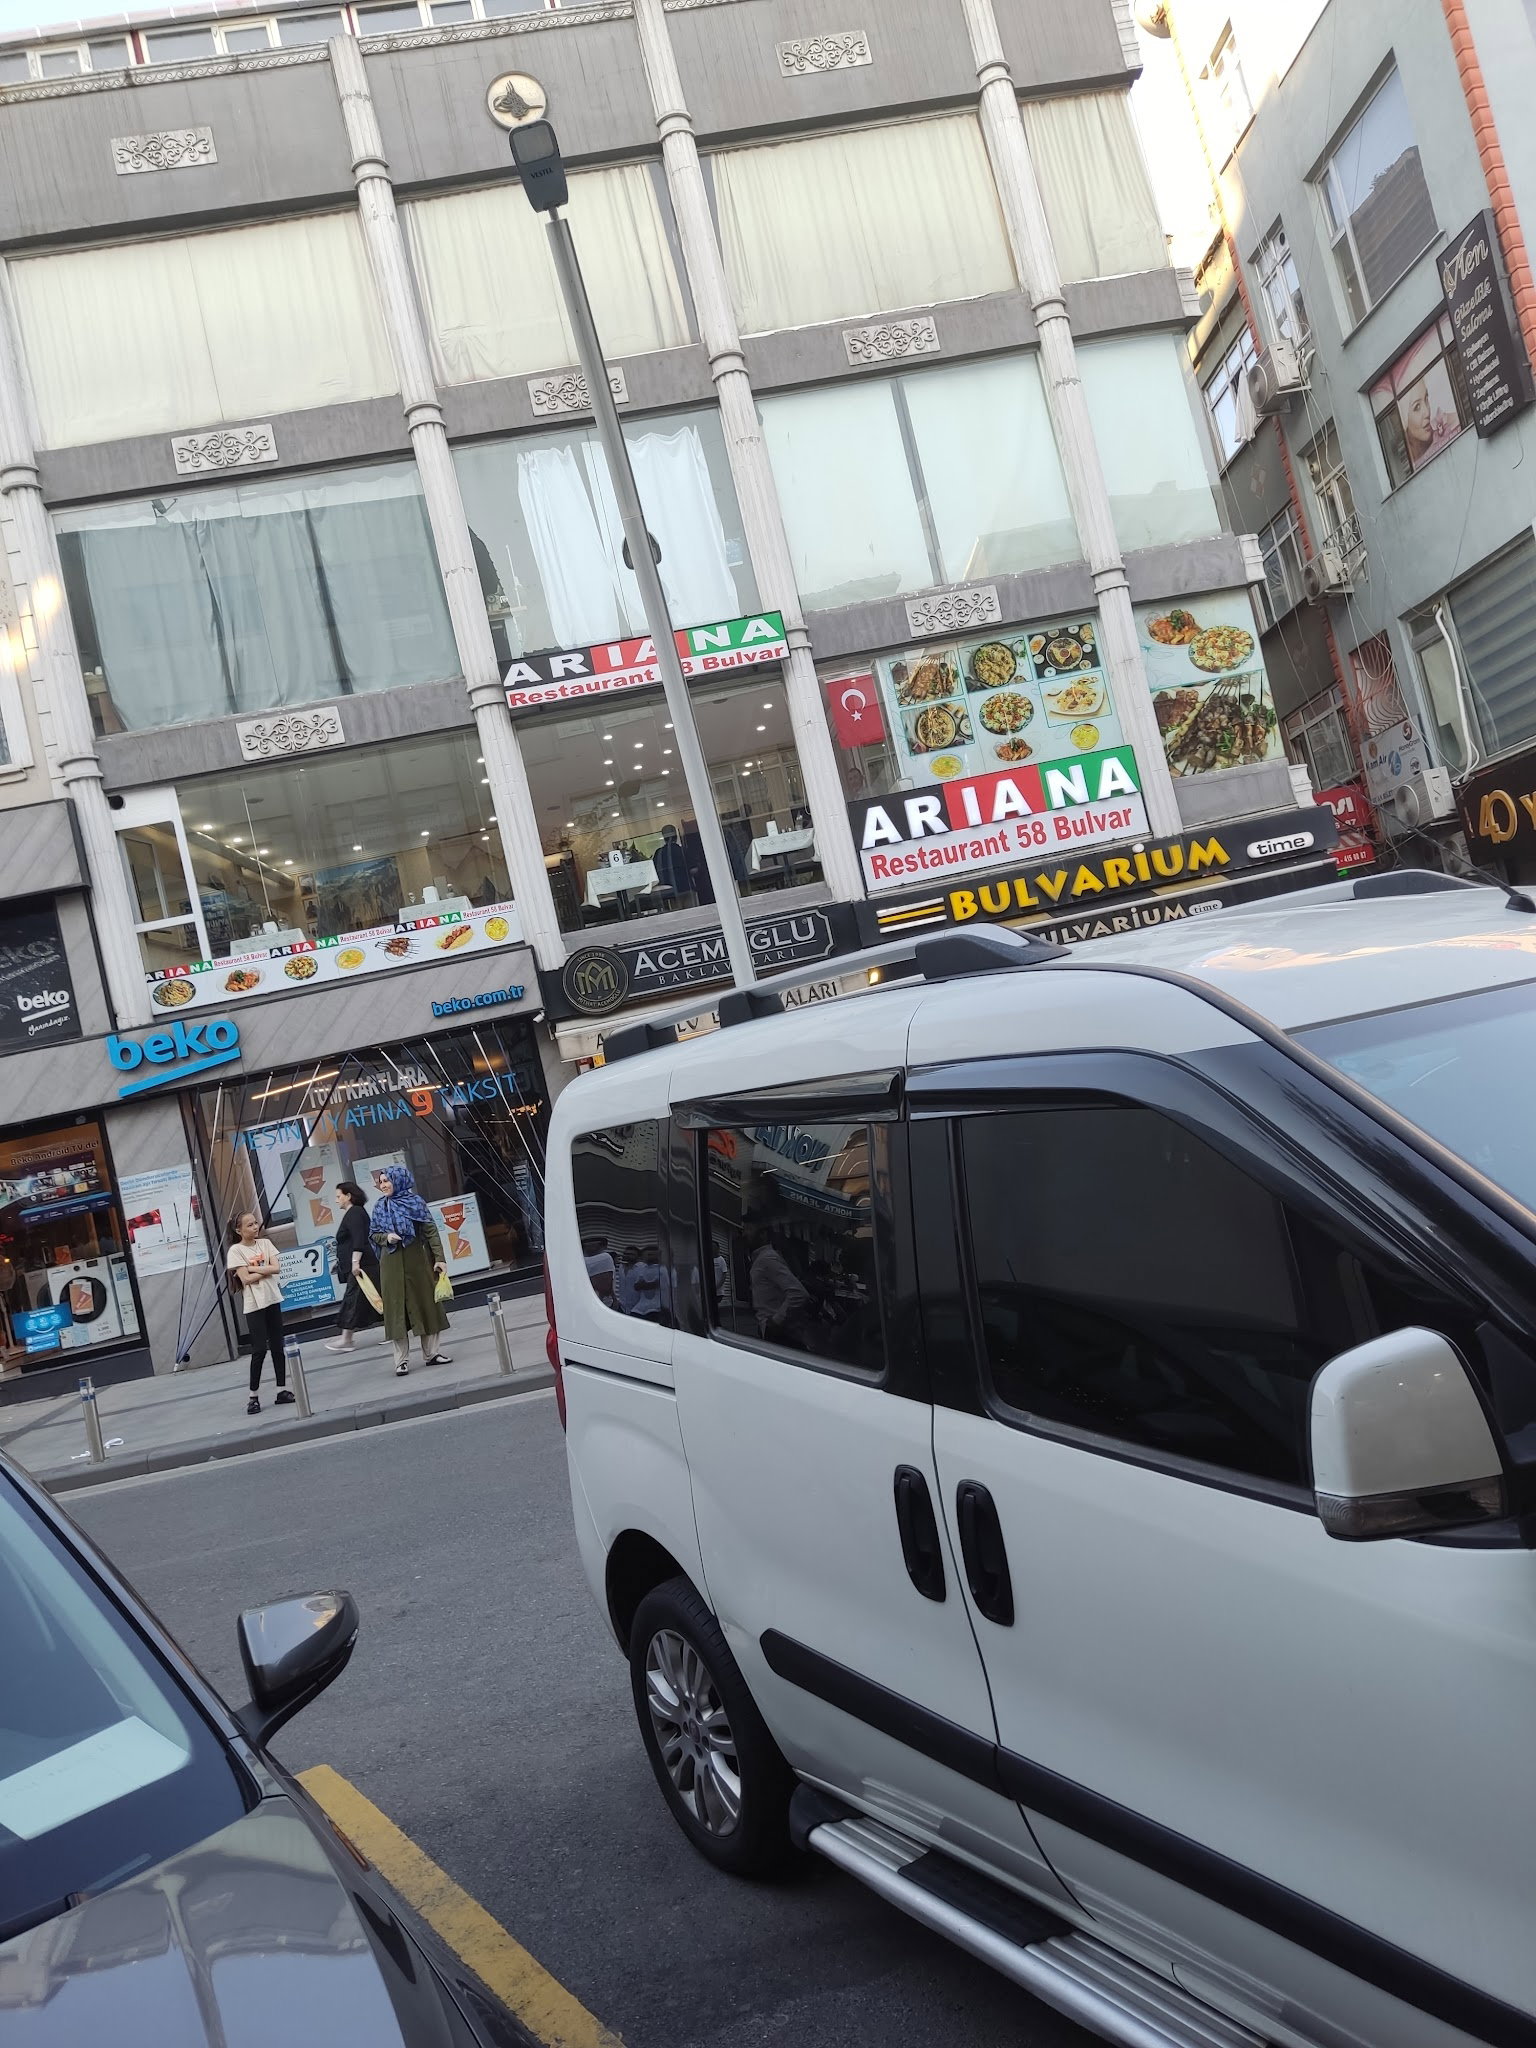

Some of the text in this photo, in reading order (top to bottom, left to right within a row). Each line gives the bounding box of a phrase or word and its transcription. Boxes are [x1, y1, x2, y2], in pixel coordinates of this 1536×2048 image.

[530, 167, 553, 179] VESTEL
[509, 668, 655, 707] Restaurant
[703, 646, 785, 670] Bulvar
[861, 757, 1139, 849] ARIANA
[613, 853, 620, 863] 6
[870, 807, 1132, 880] Restaurant 58 Bulvar
[949, 836, 1305, 922] BULVARİUM time
[145, 960, 212, 982] ARIANA
[214, 955, 243, 968] Restaurant
[271, 937, 338, 959] ARIANA
[340, 931, 368, 943] Restaurant
[396, 913, 461, 933] ARIANA
[463, 907, 490, 919] Restaurant
[1039, 902, 1218, 944] ULVARİUM time
[634, 916, 816, 977] ACEMĞLU
[658, 948, 796, 985] BAKLAVLARI
[17, 990, 70, 1011] beko
[431, 984, 524, 1017] beko.com.tr
[105, 1020, 240, 1072] beko
[344, 1066, 430, 1102] KARTLARA
[411, 1089, 433, 1117] 9
[435, 1071, 516, 1107] TAKSİT
[72, 1144, 83, 1153] TV
